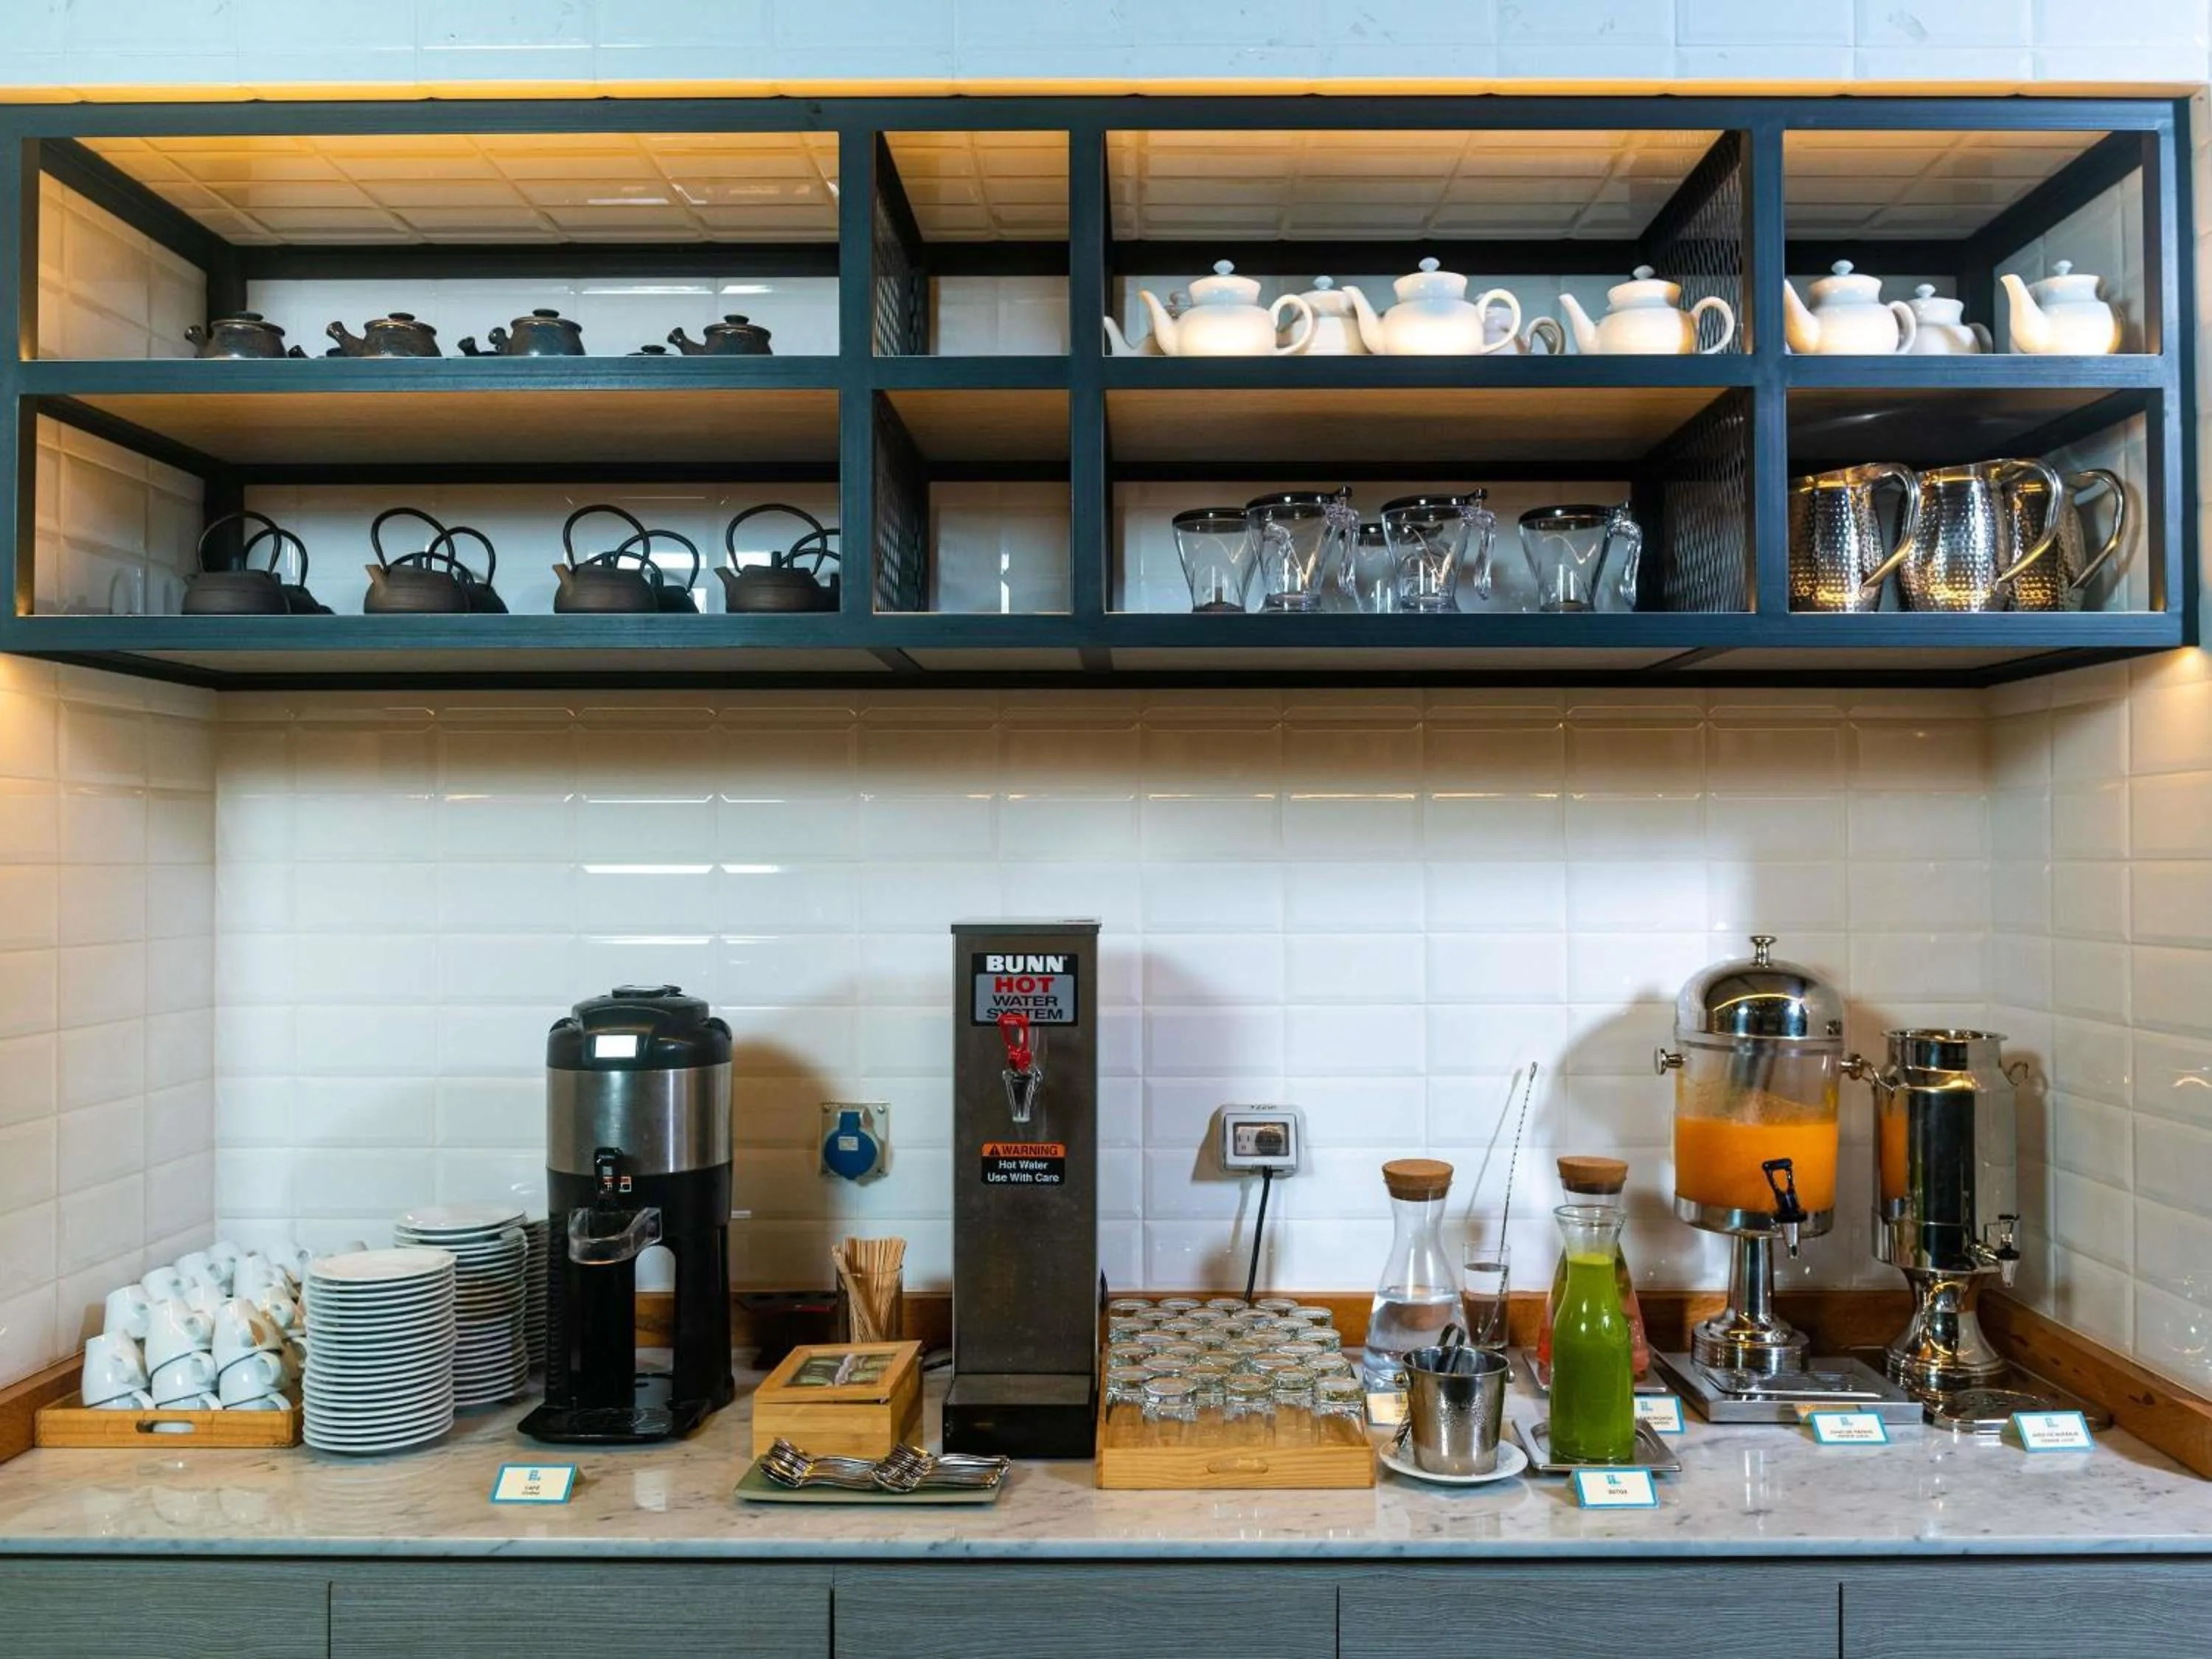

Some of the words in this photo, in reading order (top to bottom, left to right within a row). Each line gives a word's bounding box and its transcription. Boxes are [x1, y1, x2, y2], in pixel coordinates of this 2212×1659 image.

[986, 955, 1064, 973] BUNN
[995, 976, 1054, 993] HOT
[992, 995, 1057, 1006] WATER
[1002, 1145, 1058, 1156] WARNING
[998, 1160, 1017, 1169] Hot
[1018, 1160, 1048, 1169] Water
[987, 1172, 1008, 1182] Use
[1009, 1173, 1032, 1182] With
[1034, 1173, 1060, 1182] Care
